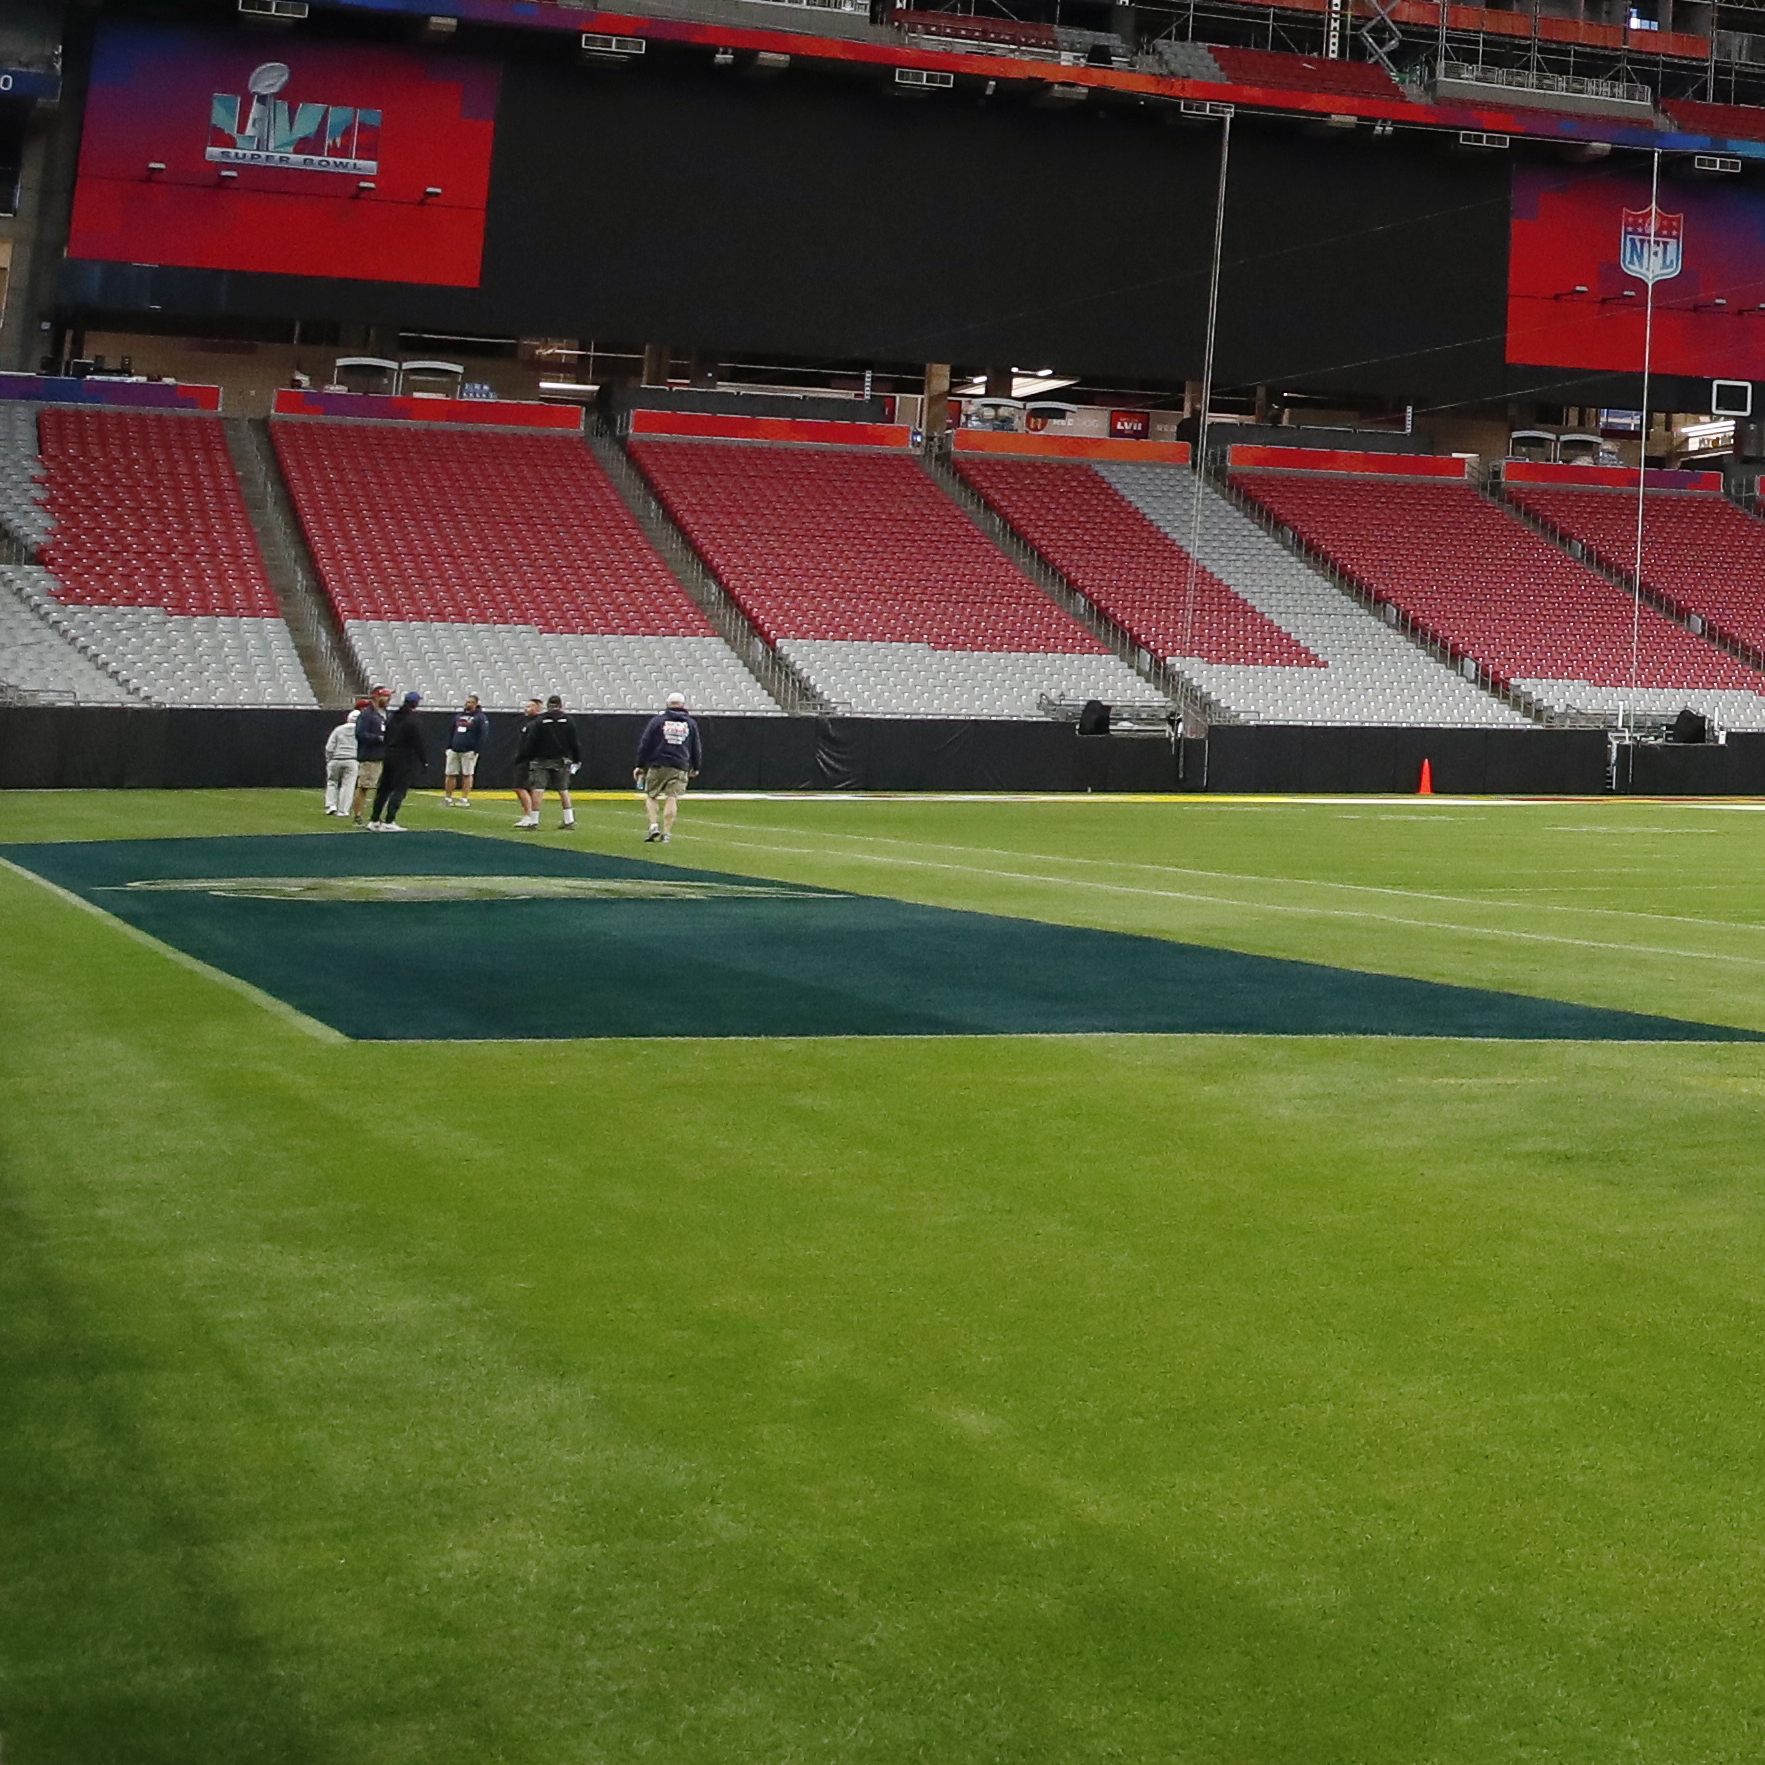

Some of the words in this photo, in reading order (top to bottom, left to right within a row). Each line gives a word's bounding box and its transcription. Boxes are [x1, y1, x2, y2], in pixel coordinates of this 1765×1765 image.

[211, 92, 382, 160] LVII
[219, 150, 291, 165] SUPER
[303, 157, 363, 171] BOWL
[1627, 236, 1676, 272] NFL
[1116, 421, 1143, 431] LVII
